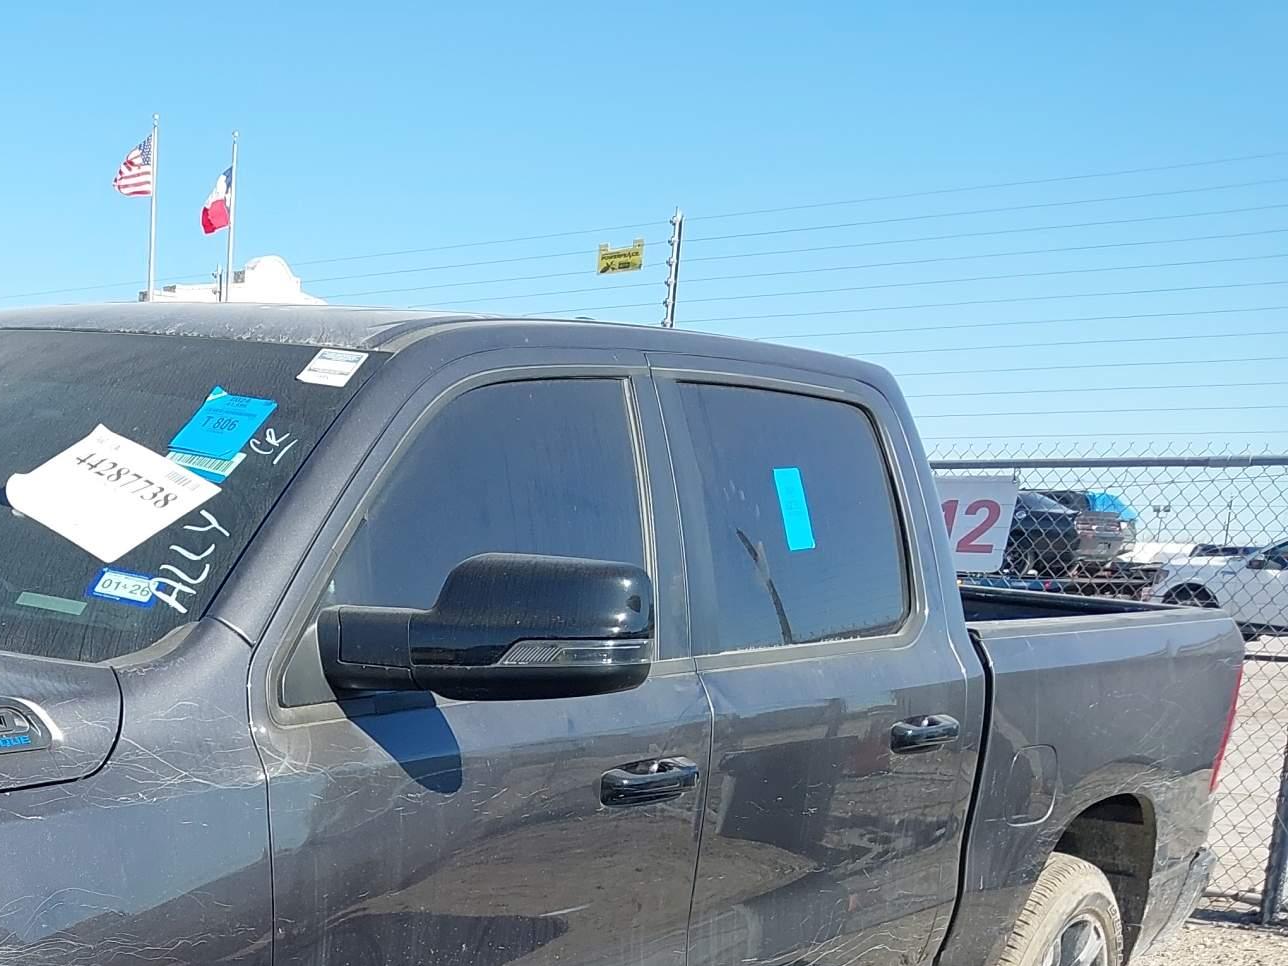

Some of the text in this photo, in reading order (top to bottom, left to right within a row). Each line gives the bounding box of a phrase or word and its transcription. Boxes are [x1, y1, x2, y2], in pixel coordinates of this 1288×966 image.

[213, 416, 239, 432] 806
[76, 452, 178, 509] 44287738
[150, 509, 230, 614] ALLY
